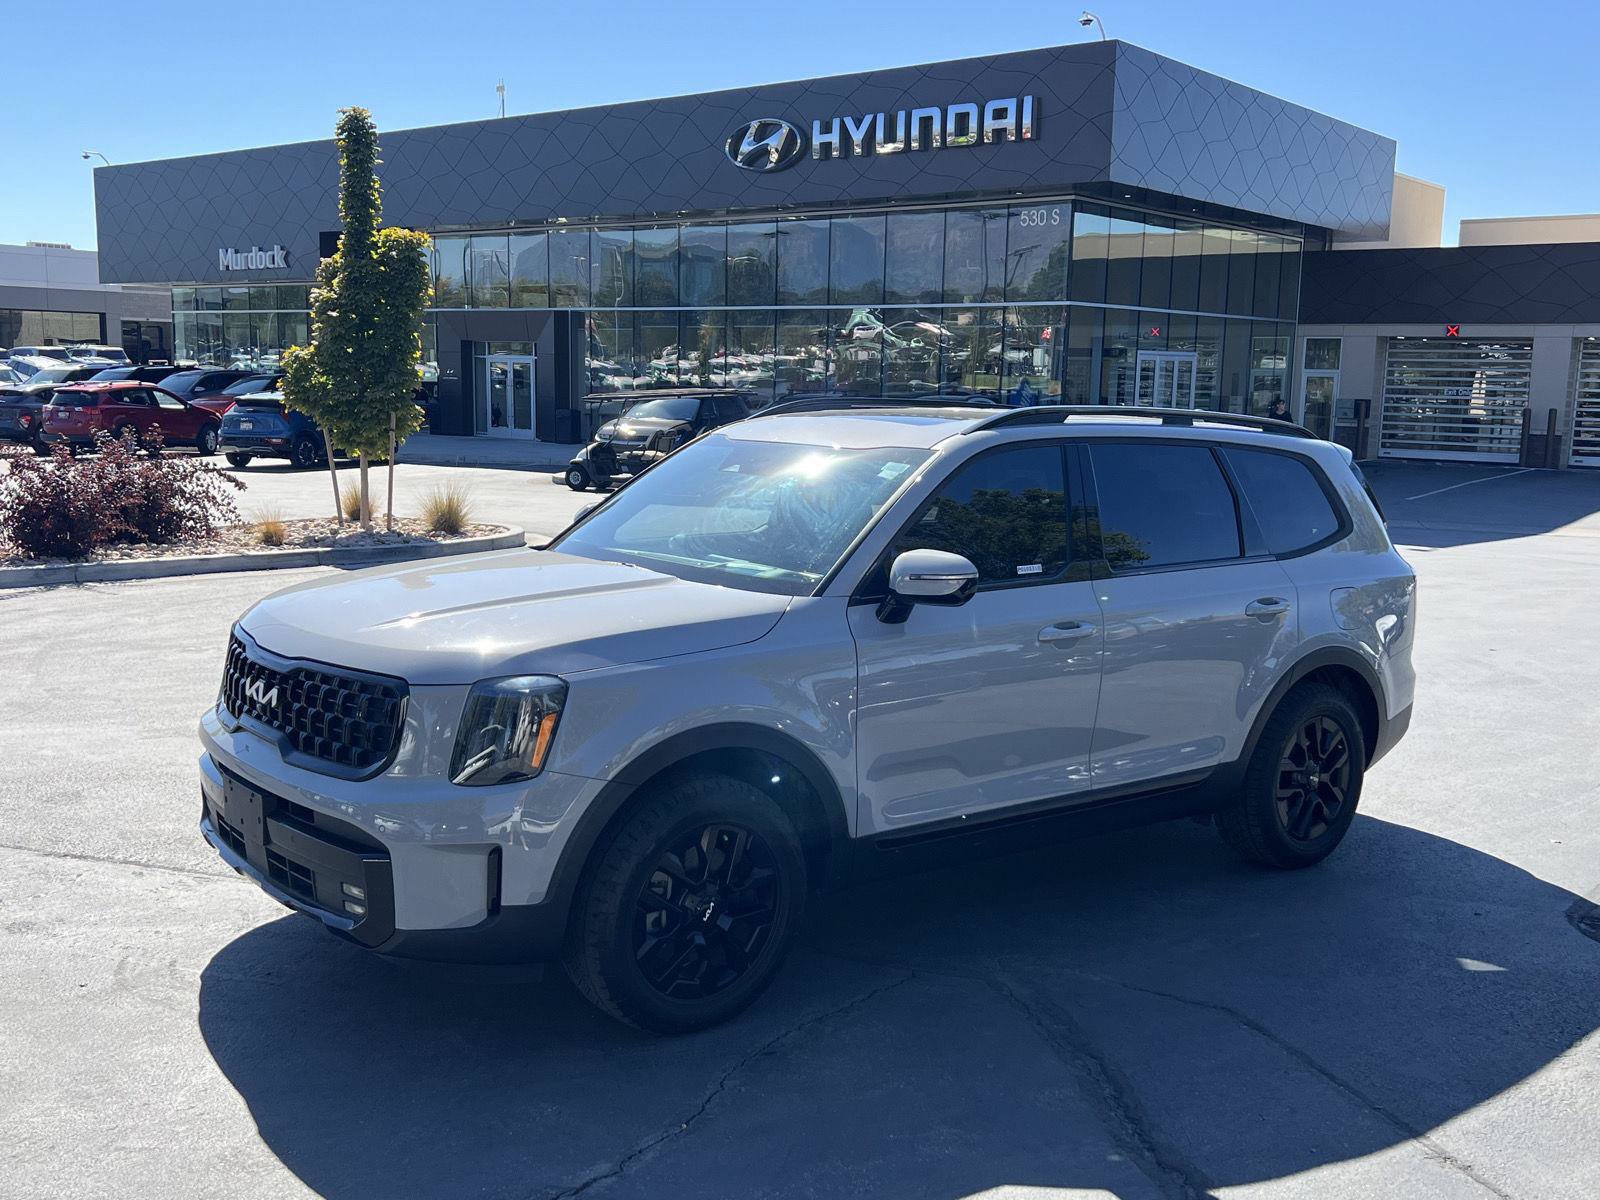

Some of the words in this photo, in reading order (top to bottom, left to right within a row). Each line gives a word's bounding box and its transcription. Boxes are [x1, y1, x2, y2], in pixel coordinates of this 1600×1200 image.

[812, 95, 1036, 160] HYUNDAI
[1020, 209, 1047, 227] 530
[1051, 208, 1060, 225] S
[218, 245, 288, 271] Murdock
[245, 675, 279, 708] KIA
